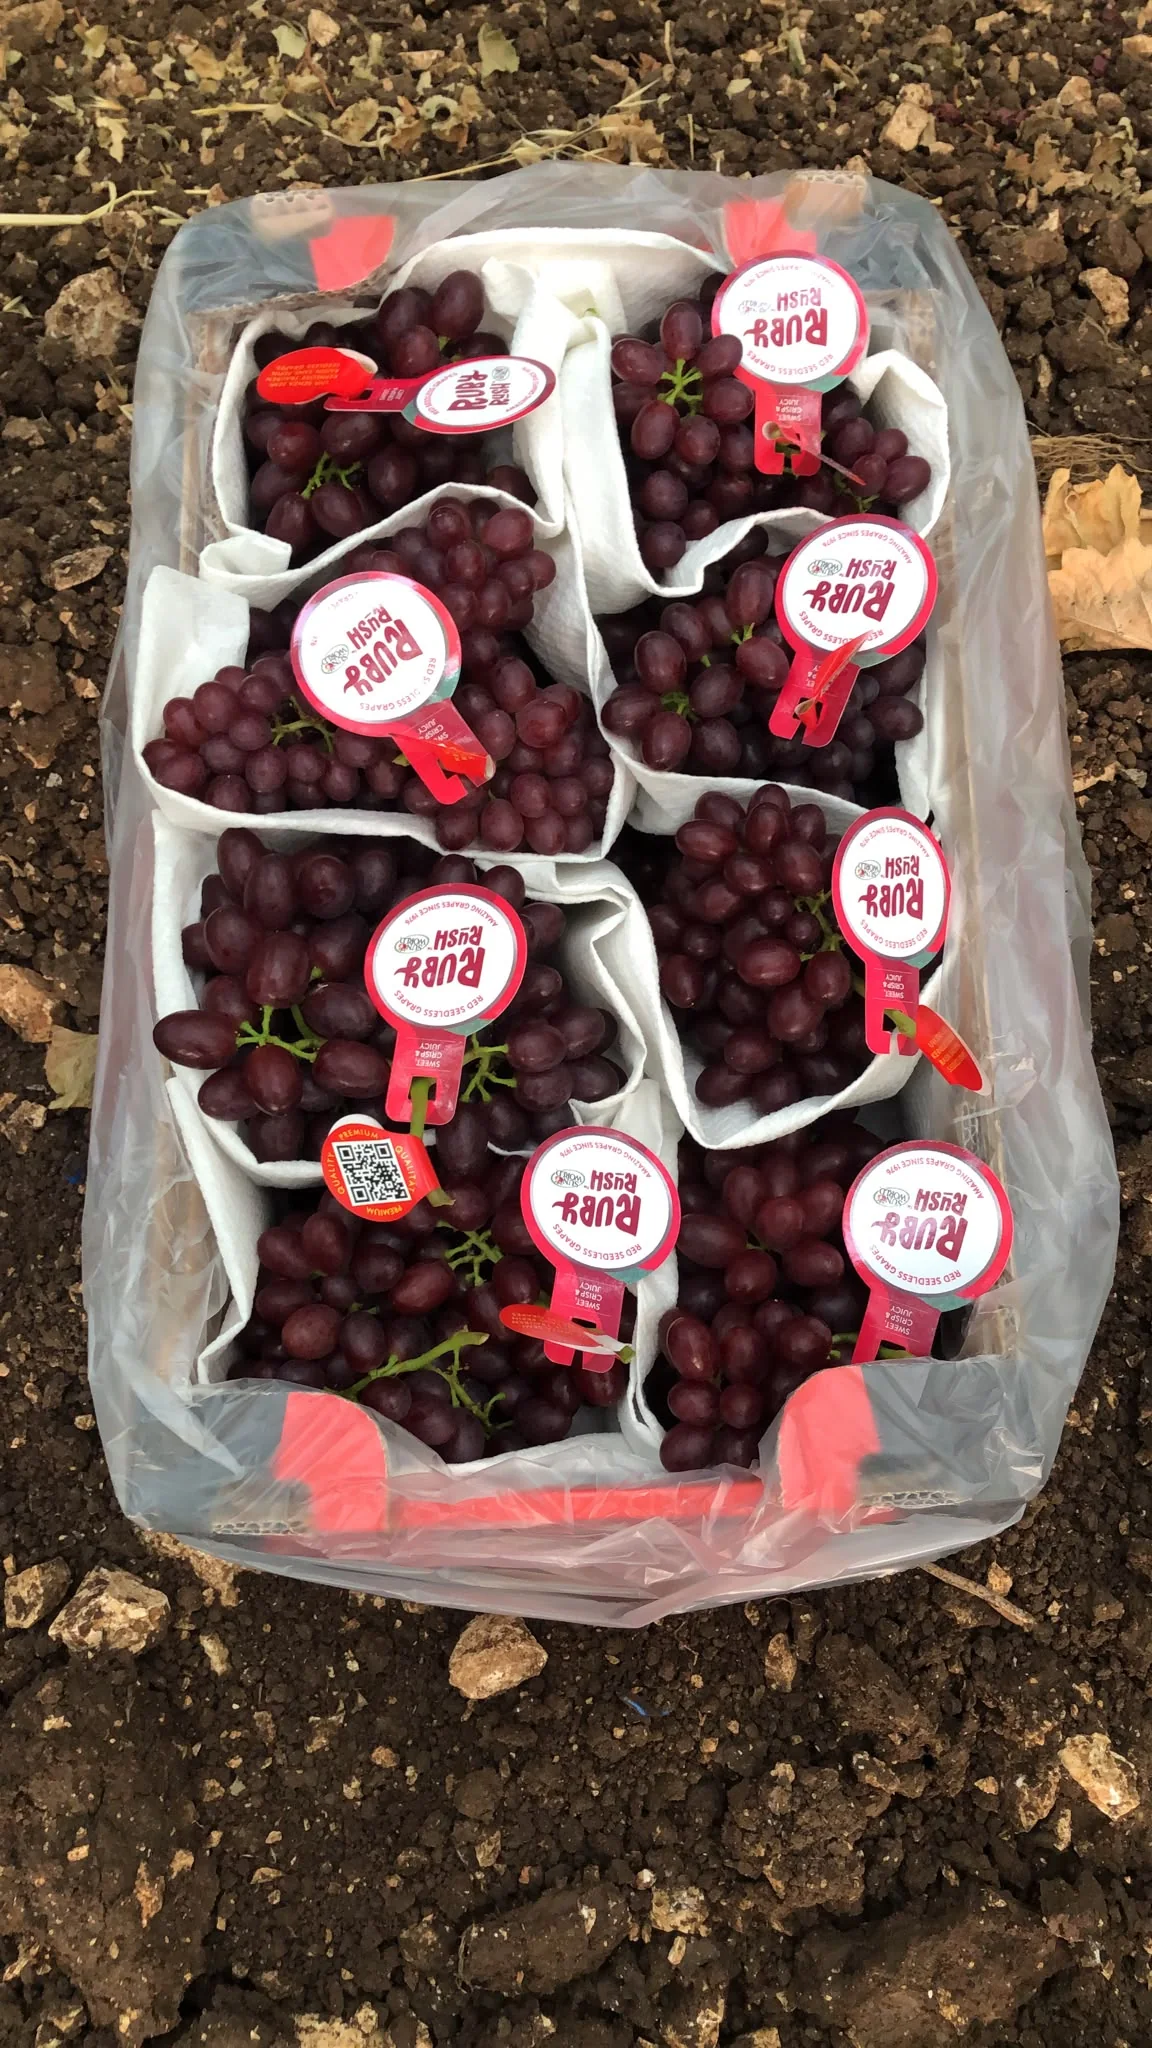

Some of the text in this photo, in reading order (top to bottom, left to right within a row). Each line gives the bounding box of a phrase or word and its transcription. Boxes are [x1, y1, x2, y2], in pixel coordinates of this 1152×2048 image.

[777, 288, 821, 311] RUSH
[744, 308, 827, 347] RUBY
[746, 350, 776, 372] GRAPES
[777, 364, 818, 375] SEEDLESS
[446, 370, 489, 412] RUBY
[837, 530, 859, 540] SINCE
[860, 529, 888, 540] GRAPES
[889, 538, 912, 564] AMAZING
[846, 558, 897, 580] RUSH
[803, 580, 895, 621] RUBY
[347, 605, 392, 650] RUSH
[799, 611, 823, 636] GRAPES
[343, 619, 423, 696] RUBY
[426, 658, 436, 675] RED
[359, 702, 395, 711] GRAPES
[417, 718, 436, 734] JUICY
[859, 826, 930, 858] AMAZING GRAPES SINCE 1976
[885, 855, 920, 878] RUSH
[858, 878, 924, 920] RUBY
[404, 901, 498, 927] AMAZING GRAPES SINCE 1976
[434, 926, 483, 950] RUSH
[860, 919, 928, 948] RED SEEDLESS GRAPES
[394, 947, 485, 988] RUBY
[886, 974, 903, 982] JUICY
[394, 990, 484, 1017] RED SEEDLESS GRAPES
[884, 989, 904, 998] SWEET,
[416, 1059, 440, 1067] SWEET,
[420, 1050, 442, 1058] CRISP
[338, 1129, 379, 1140] PREMIUM
[559, 1142, 651, 1178] AMAZING GRAPES SINCE 1976
[327, 1152, 345, 1194] QUALITY
[590, 1170, 637, 1193] RUSH
[885, 1158, 984, 1199] AMAZING GRAPES SINCE 1976
[366, 1206, 402, 1216] PREMIUM
[914, 1189, 967, 1216] RUSH
[552, 1193, 641, 1237] RUBY
[553, 1224, 642, 1260] RED SEEDLESS GRAPES
[871, 1212, 968, 1262] RUBY
[870, 1244, 962, 1285] RED SEEDLESS GRAPES
[579, 1282, 602, 1293] JUICY
[581, 1290, 602, 1300] CRISP
[575, 1298, 600, 1311] SWEET,
[890, 1305, 913, 1316] JUICY
[885, 1321, 910, 1335] SWEET,
[890, 1314, 913, 1326] CRISP
